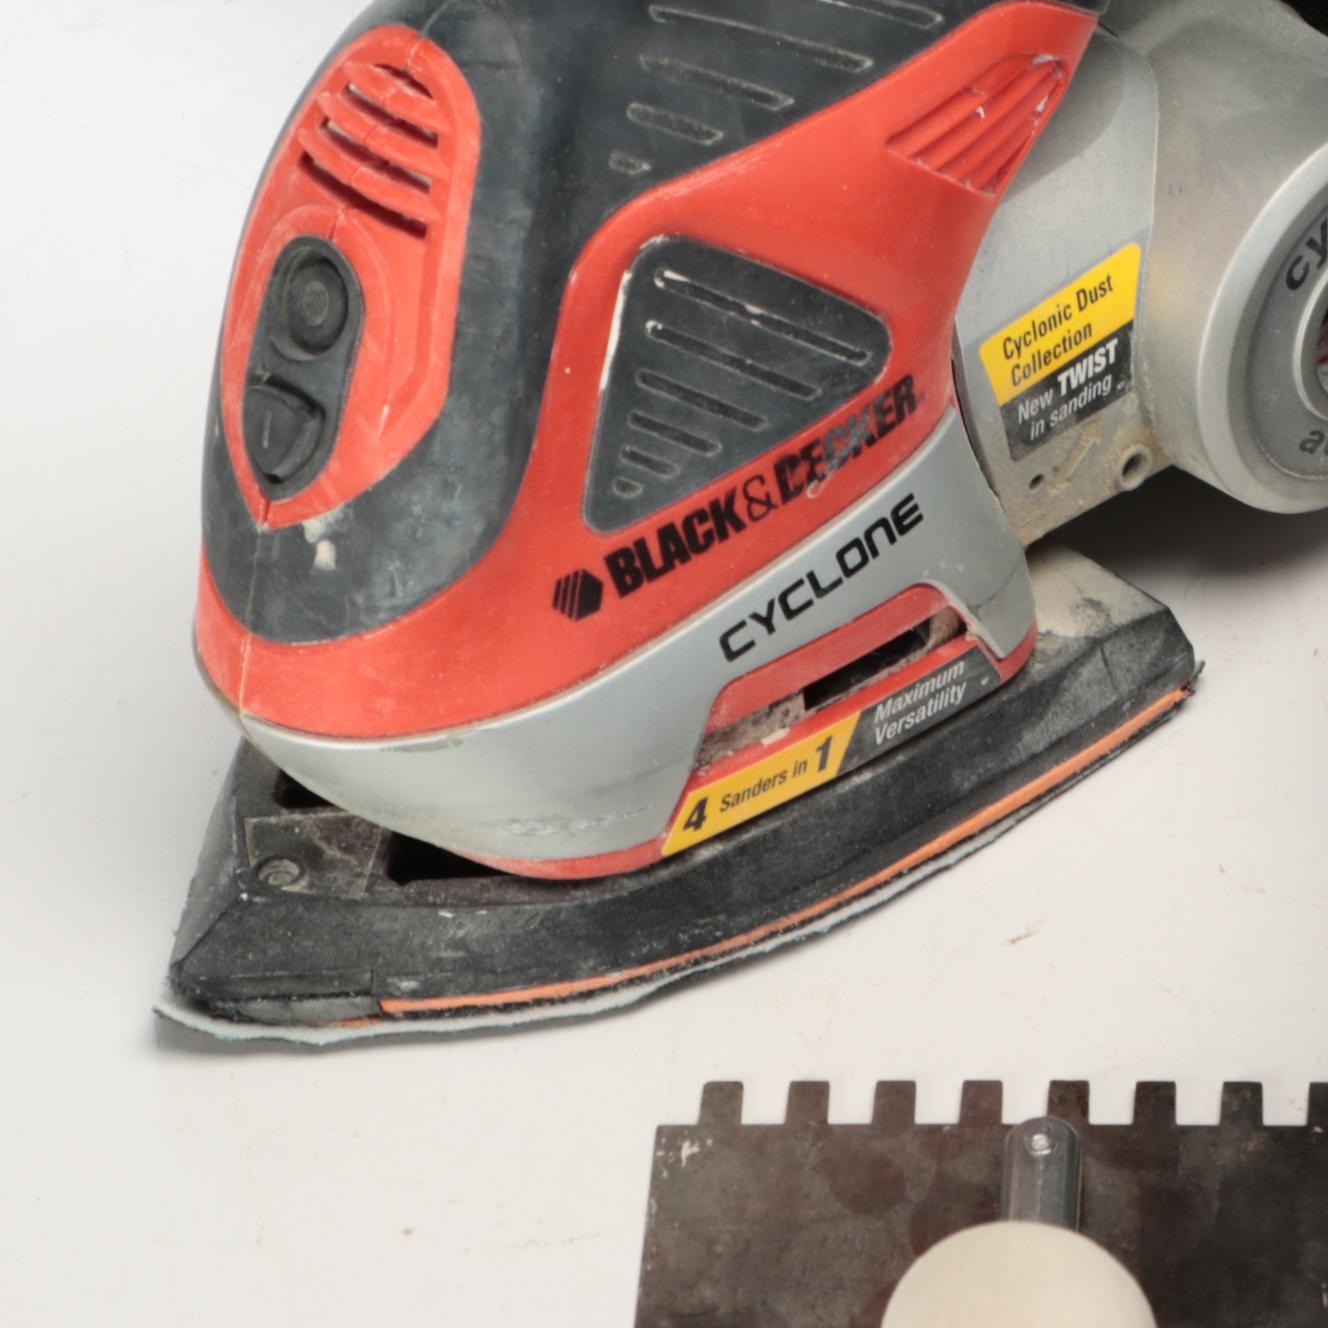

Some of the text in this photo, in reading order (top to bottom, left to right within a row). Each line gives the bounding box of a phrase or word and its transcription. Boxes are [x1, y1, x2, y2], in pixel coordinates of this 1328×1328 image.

[1002, 274, 1114, 360] Cyclonic Dust
[1010, 323, 1093, 387] Collection
[1018, 338, 1119, 424] New TWIST
[1030, 374, 1112, 441] in sanding
[719, 493, 924, 662] CYCLONE
[873, 660, 965, 724] Maximum
[875, 681, 967, 745] Versatility
[683, 736, 833, 832] 4 Sanders in 1
